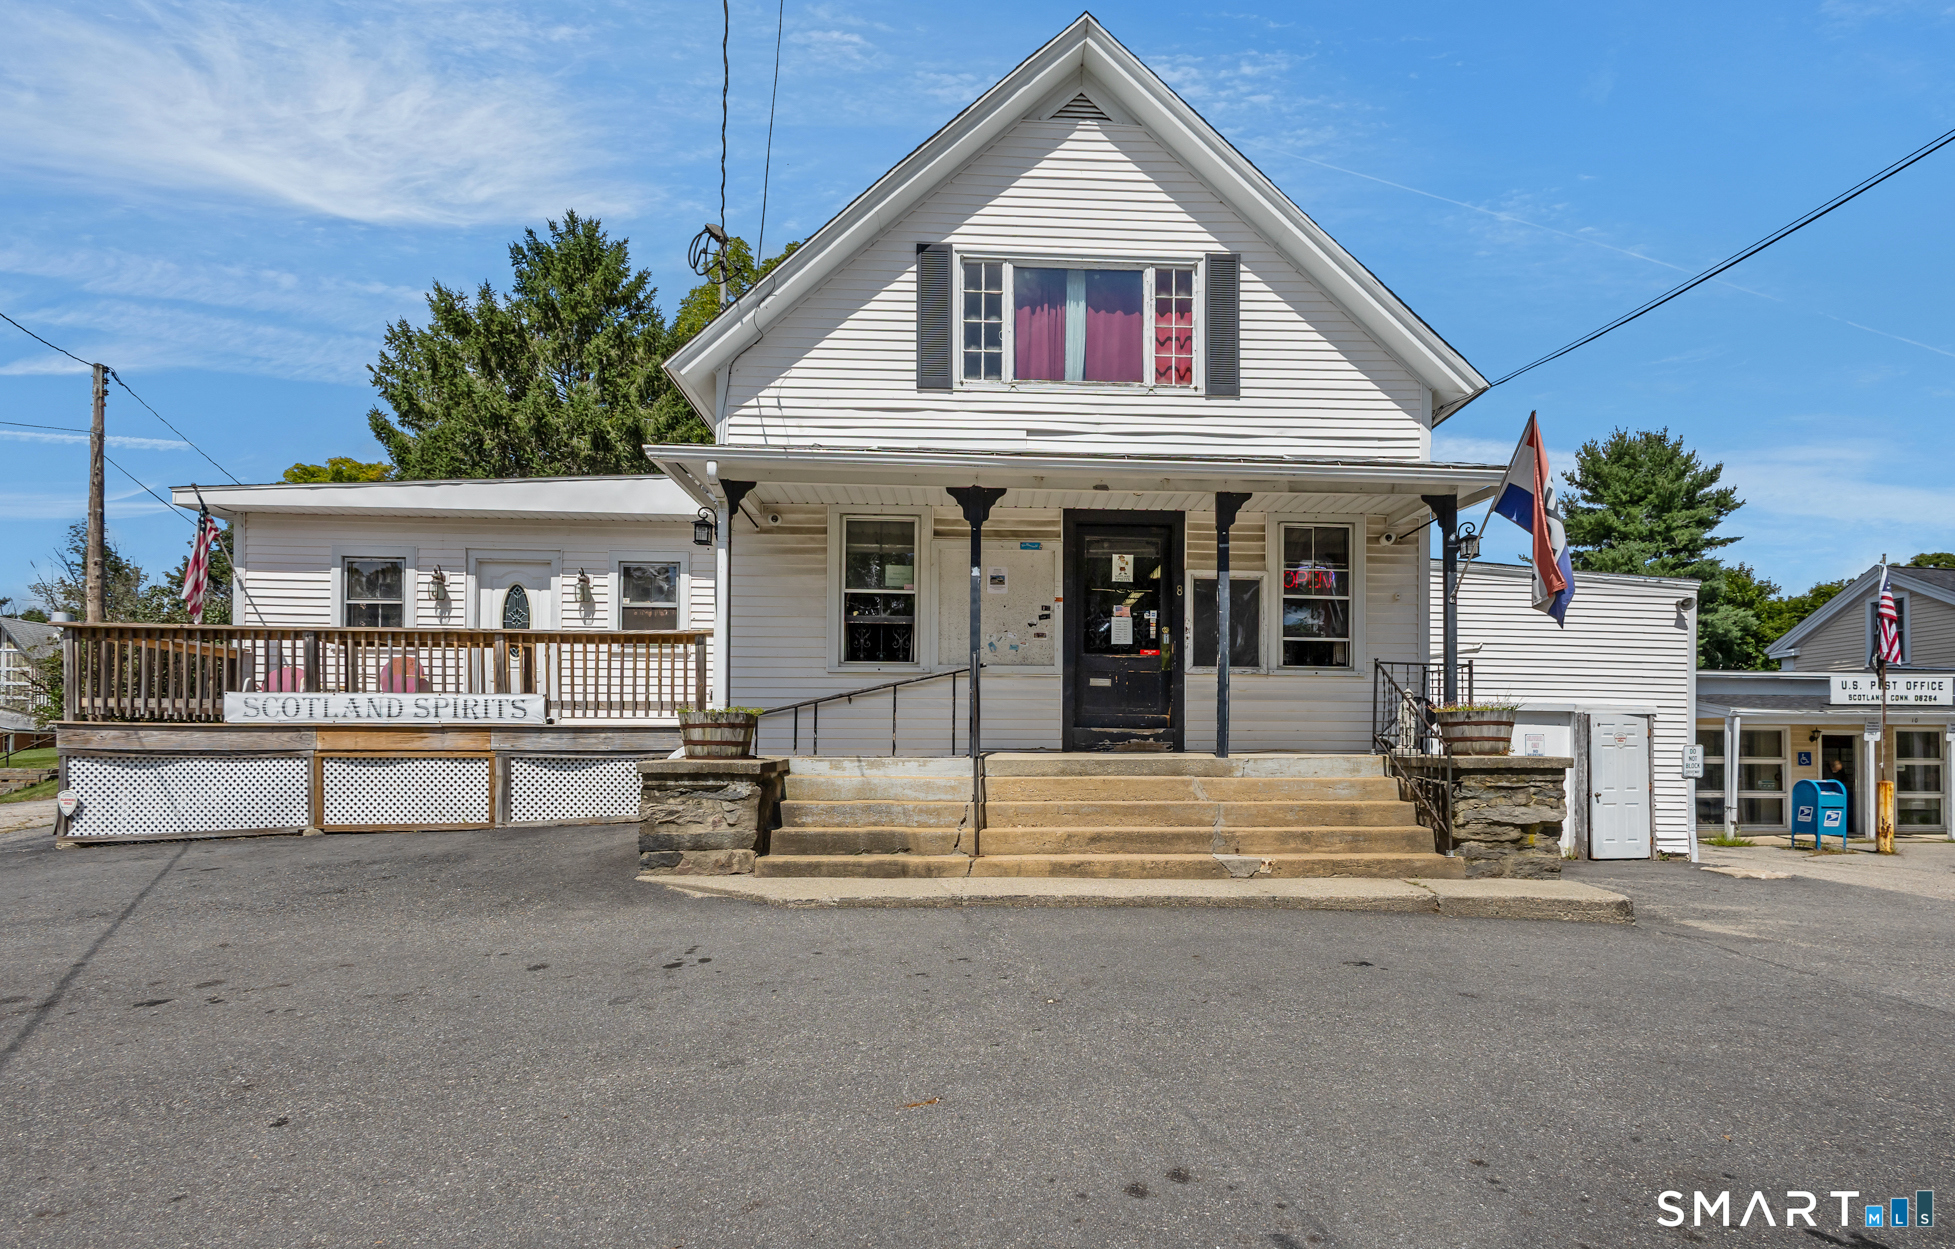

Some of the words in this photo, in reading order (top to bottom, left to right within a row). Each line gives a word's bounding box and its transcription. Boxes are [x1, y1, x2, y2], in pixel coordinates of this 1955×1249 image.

[1283, 570, 1332, 588] OPEN
[1176, 585, 1183, 596] 8
[1841, 680, 1862, 690] U.S.
[1905, 681, 1944, 691] OFFICE
[242, 696, 404, 719] SCOTLAND
[413, 697, 528, 720] SPIRITS
